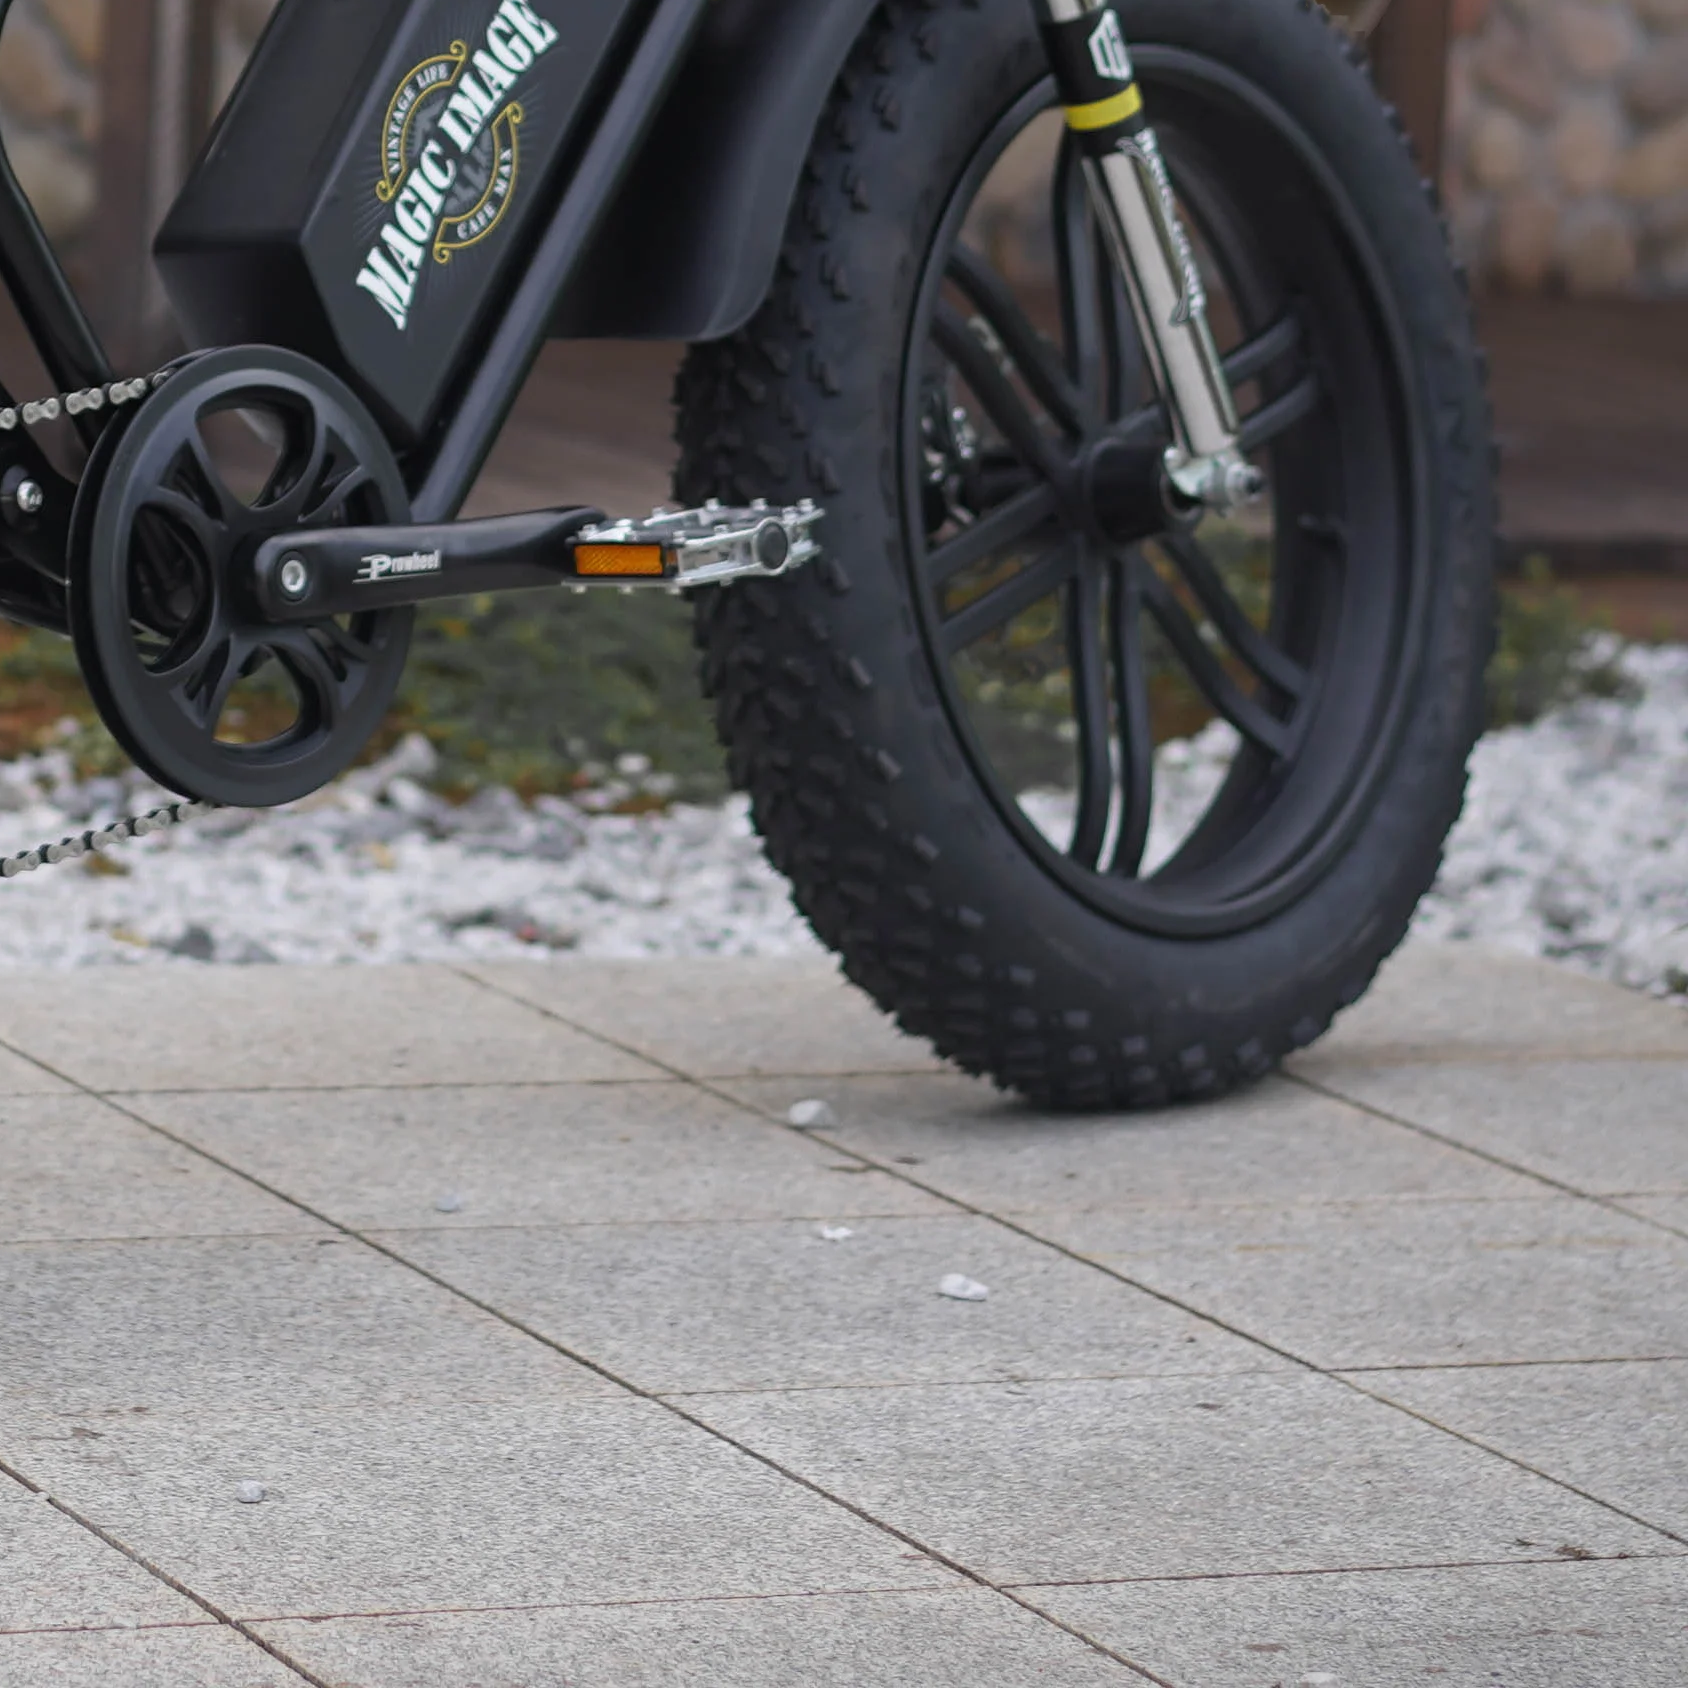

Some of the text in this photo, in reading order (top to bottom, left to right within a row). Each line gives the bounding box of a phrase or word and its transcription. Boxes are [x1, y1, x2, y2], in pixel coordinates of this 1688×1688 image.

[387, 63, 448, 174] VINTAGE LIFE
[355, 139, 456, 331] MAGIC
[356, 549, 441, 581] Prowheel
